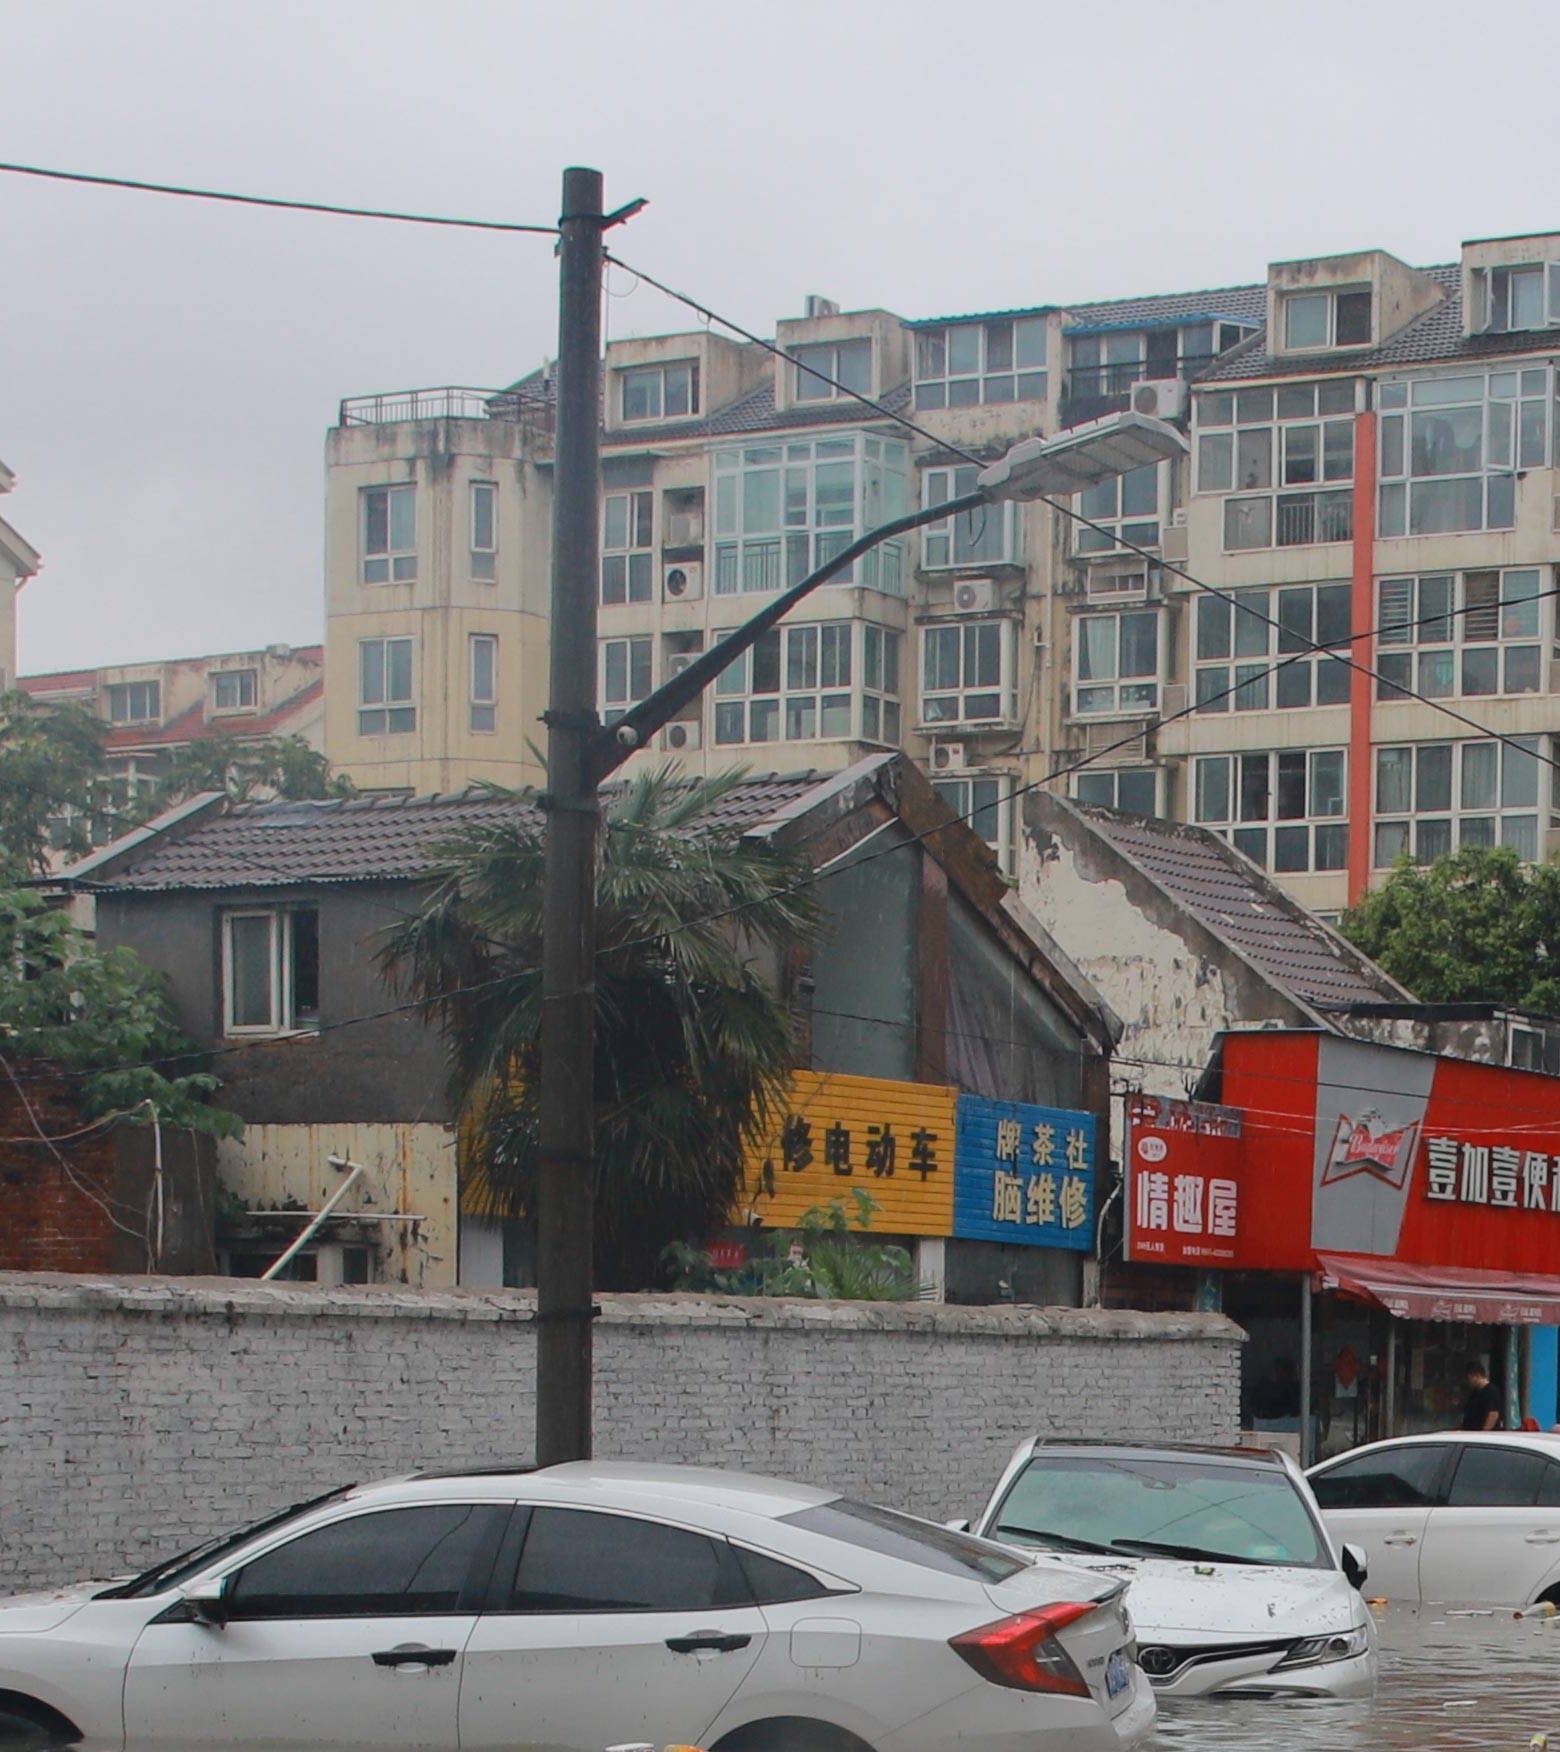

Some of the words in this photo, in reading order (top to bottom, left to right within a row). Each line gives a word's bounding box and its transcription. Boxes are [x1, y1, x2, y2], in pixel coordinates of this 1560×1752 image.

[781, 1113, 938, 1182] 修电动车
[997, 1118, 1088, 1171] 牌茶社
[993, 1170, 1088, 1230] 脑维修
[1137, 1170, 1237, 1237] 情趣屋
